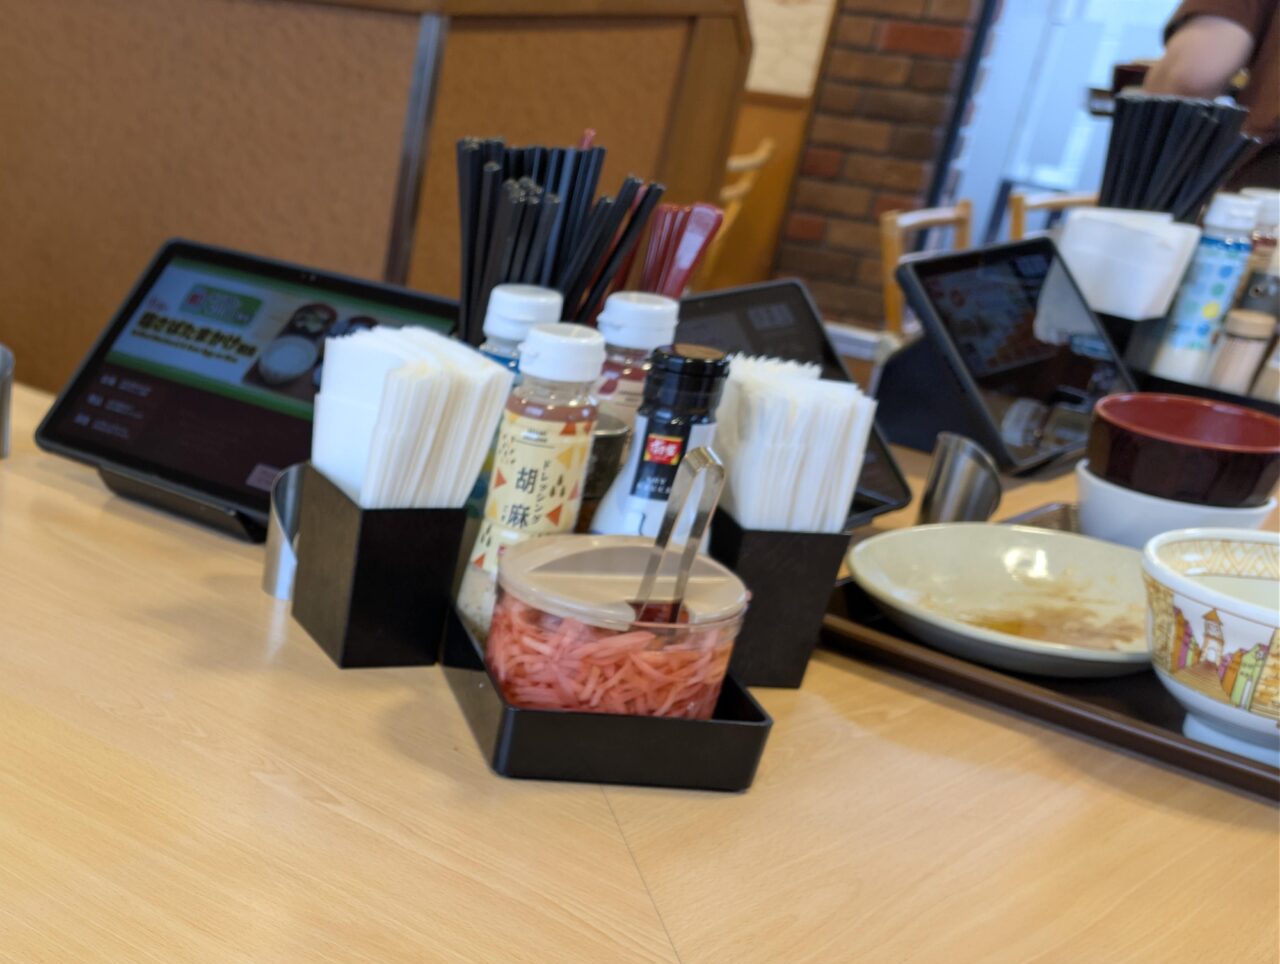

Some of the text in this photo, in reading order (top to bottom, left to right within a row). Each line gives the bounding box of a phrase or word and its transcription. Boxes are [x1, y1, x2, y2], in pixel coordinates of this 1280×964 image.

[508, 466, 539, 529] 胡麻
[531, 460, 551, 525] ドレッシング
